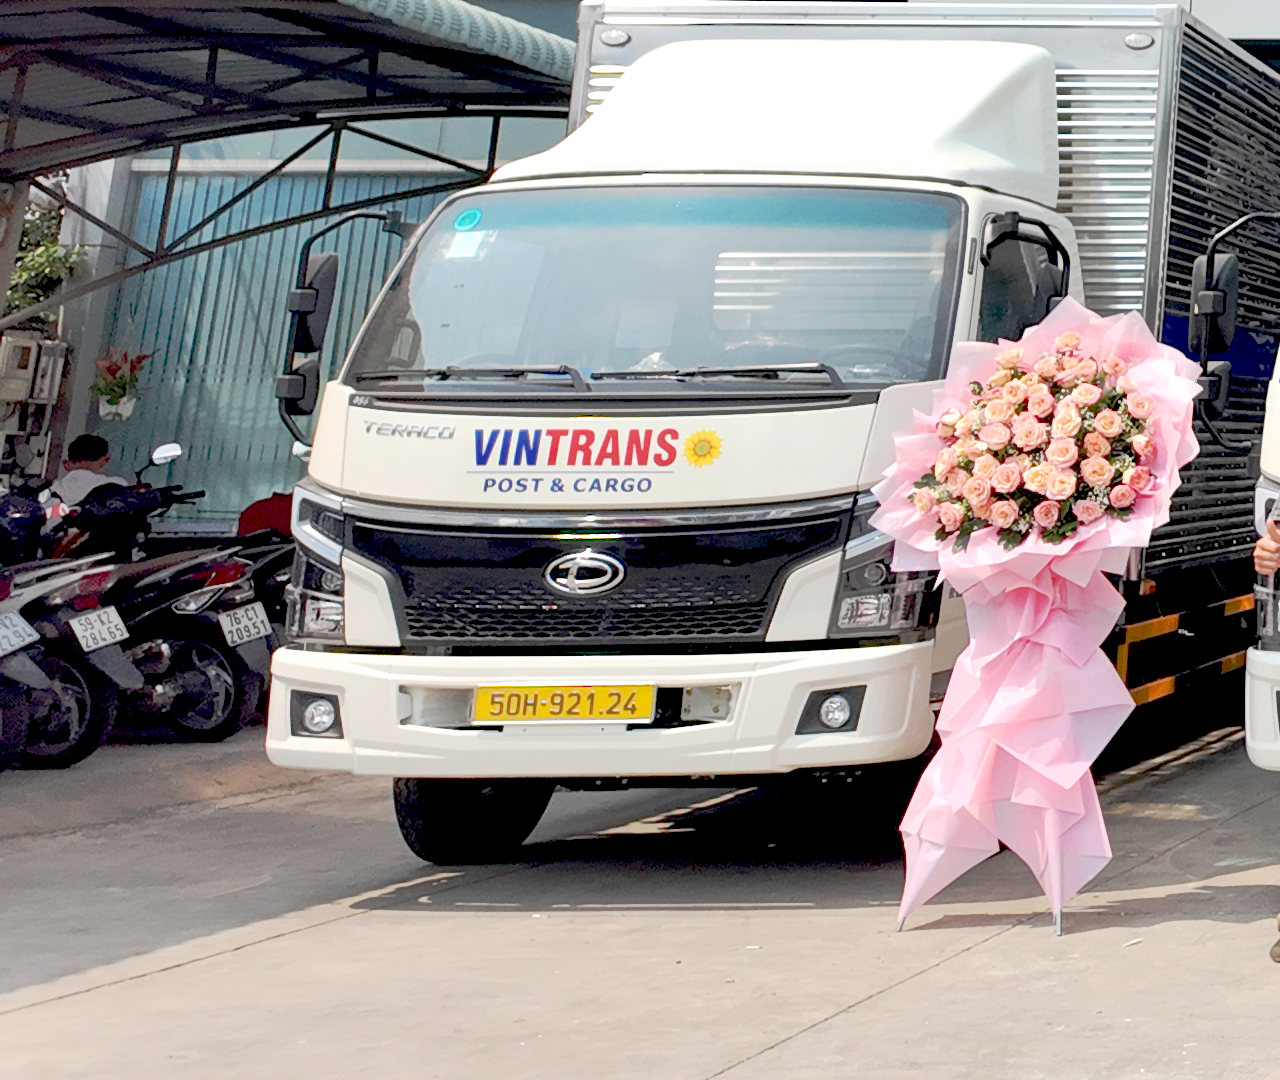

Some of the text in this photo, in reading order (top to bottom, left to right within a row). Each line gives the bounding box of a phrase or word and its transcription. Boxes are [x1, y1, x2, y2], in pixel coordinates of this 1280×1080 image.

[364, 420, 456, 440] TERACO
[474, 428, 680, 467] VINTRANS
[483, 477, 653, 493] POST & CARGO
[489, 691, 638, 716] 50H-921.24
